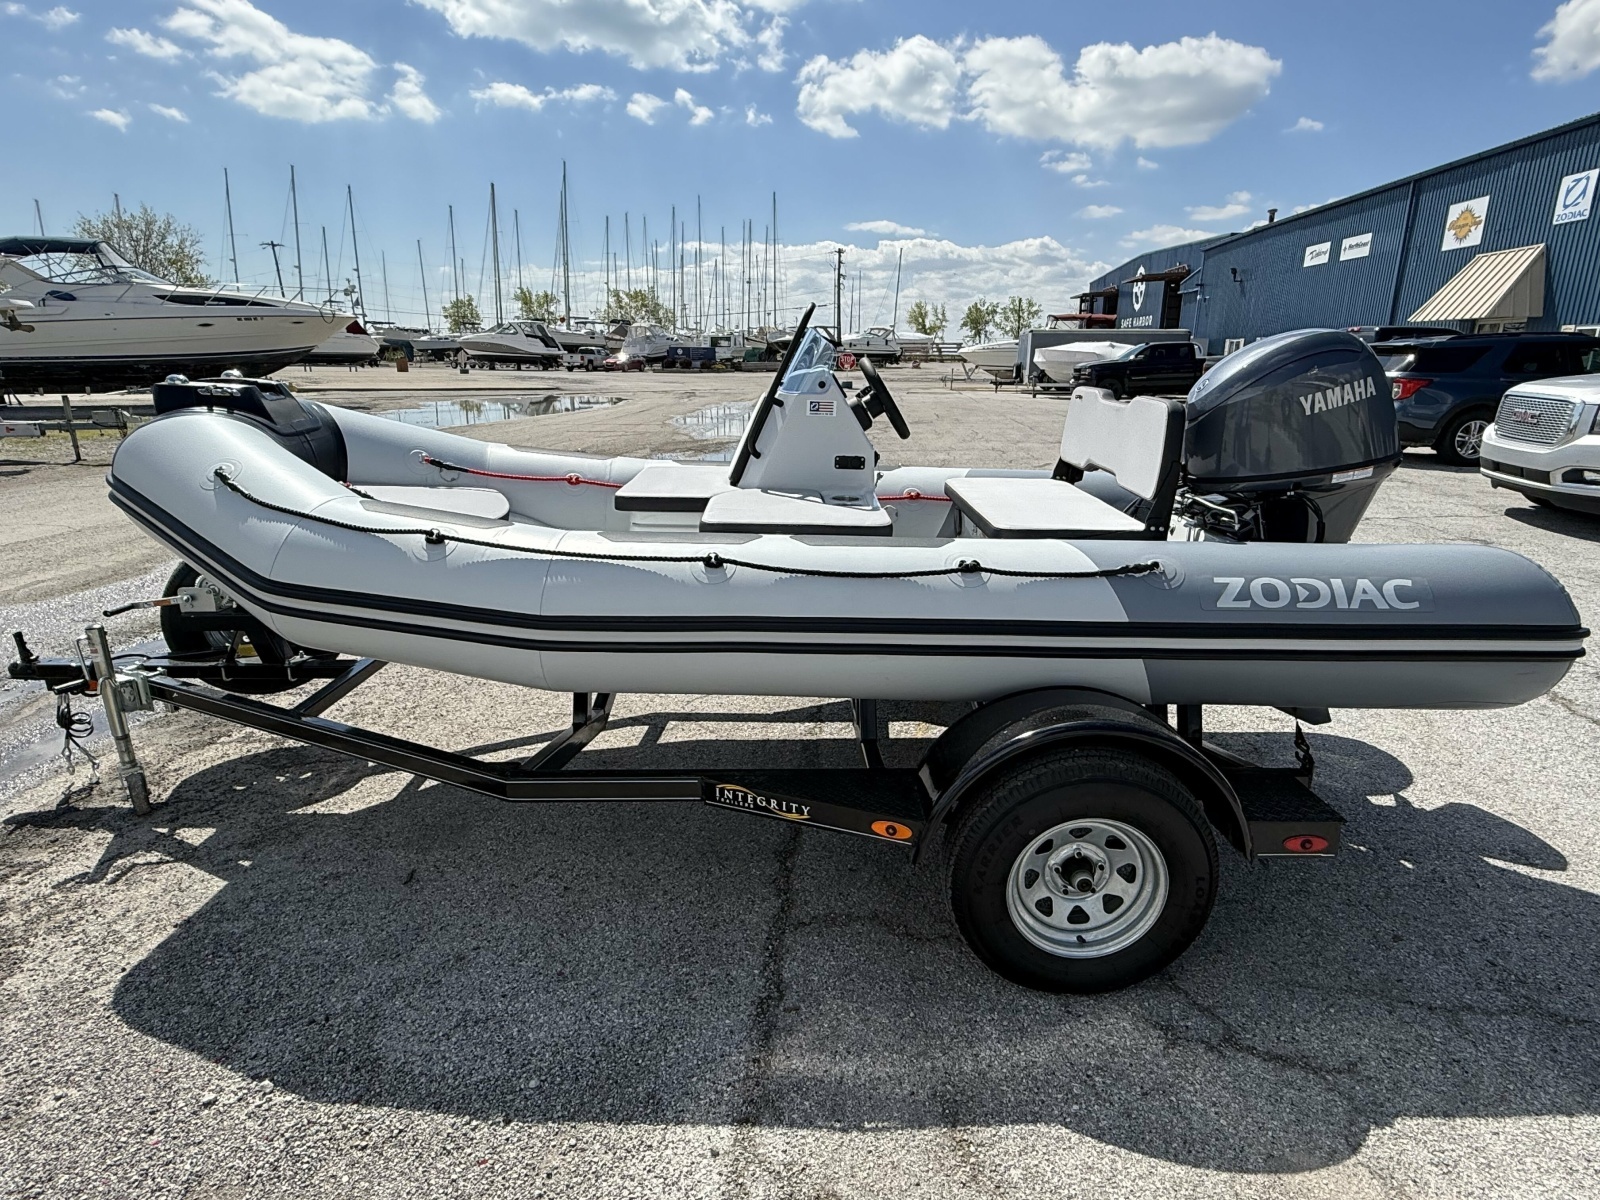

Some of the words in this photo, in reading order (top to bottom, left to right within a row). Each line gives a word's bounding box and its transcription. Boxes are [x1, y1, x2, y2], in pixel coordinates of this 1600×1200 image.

[1555, 208, 1588, 222] ZODIAC
[1121, 318, 1132, 328] SAFE
[1133, 315, 1153, 327] HARBOR
[1299, 376, 1377, 416] YAMAHA
[1213, 577, 1420, 610] ZODIAC
[715, 787, 811, 816] INTEGRITY
[716, 796, 754, 809] TRAILERS
[973, 815, 1025, 895] KARRIER
